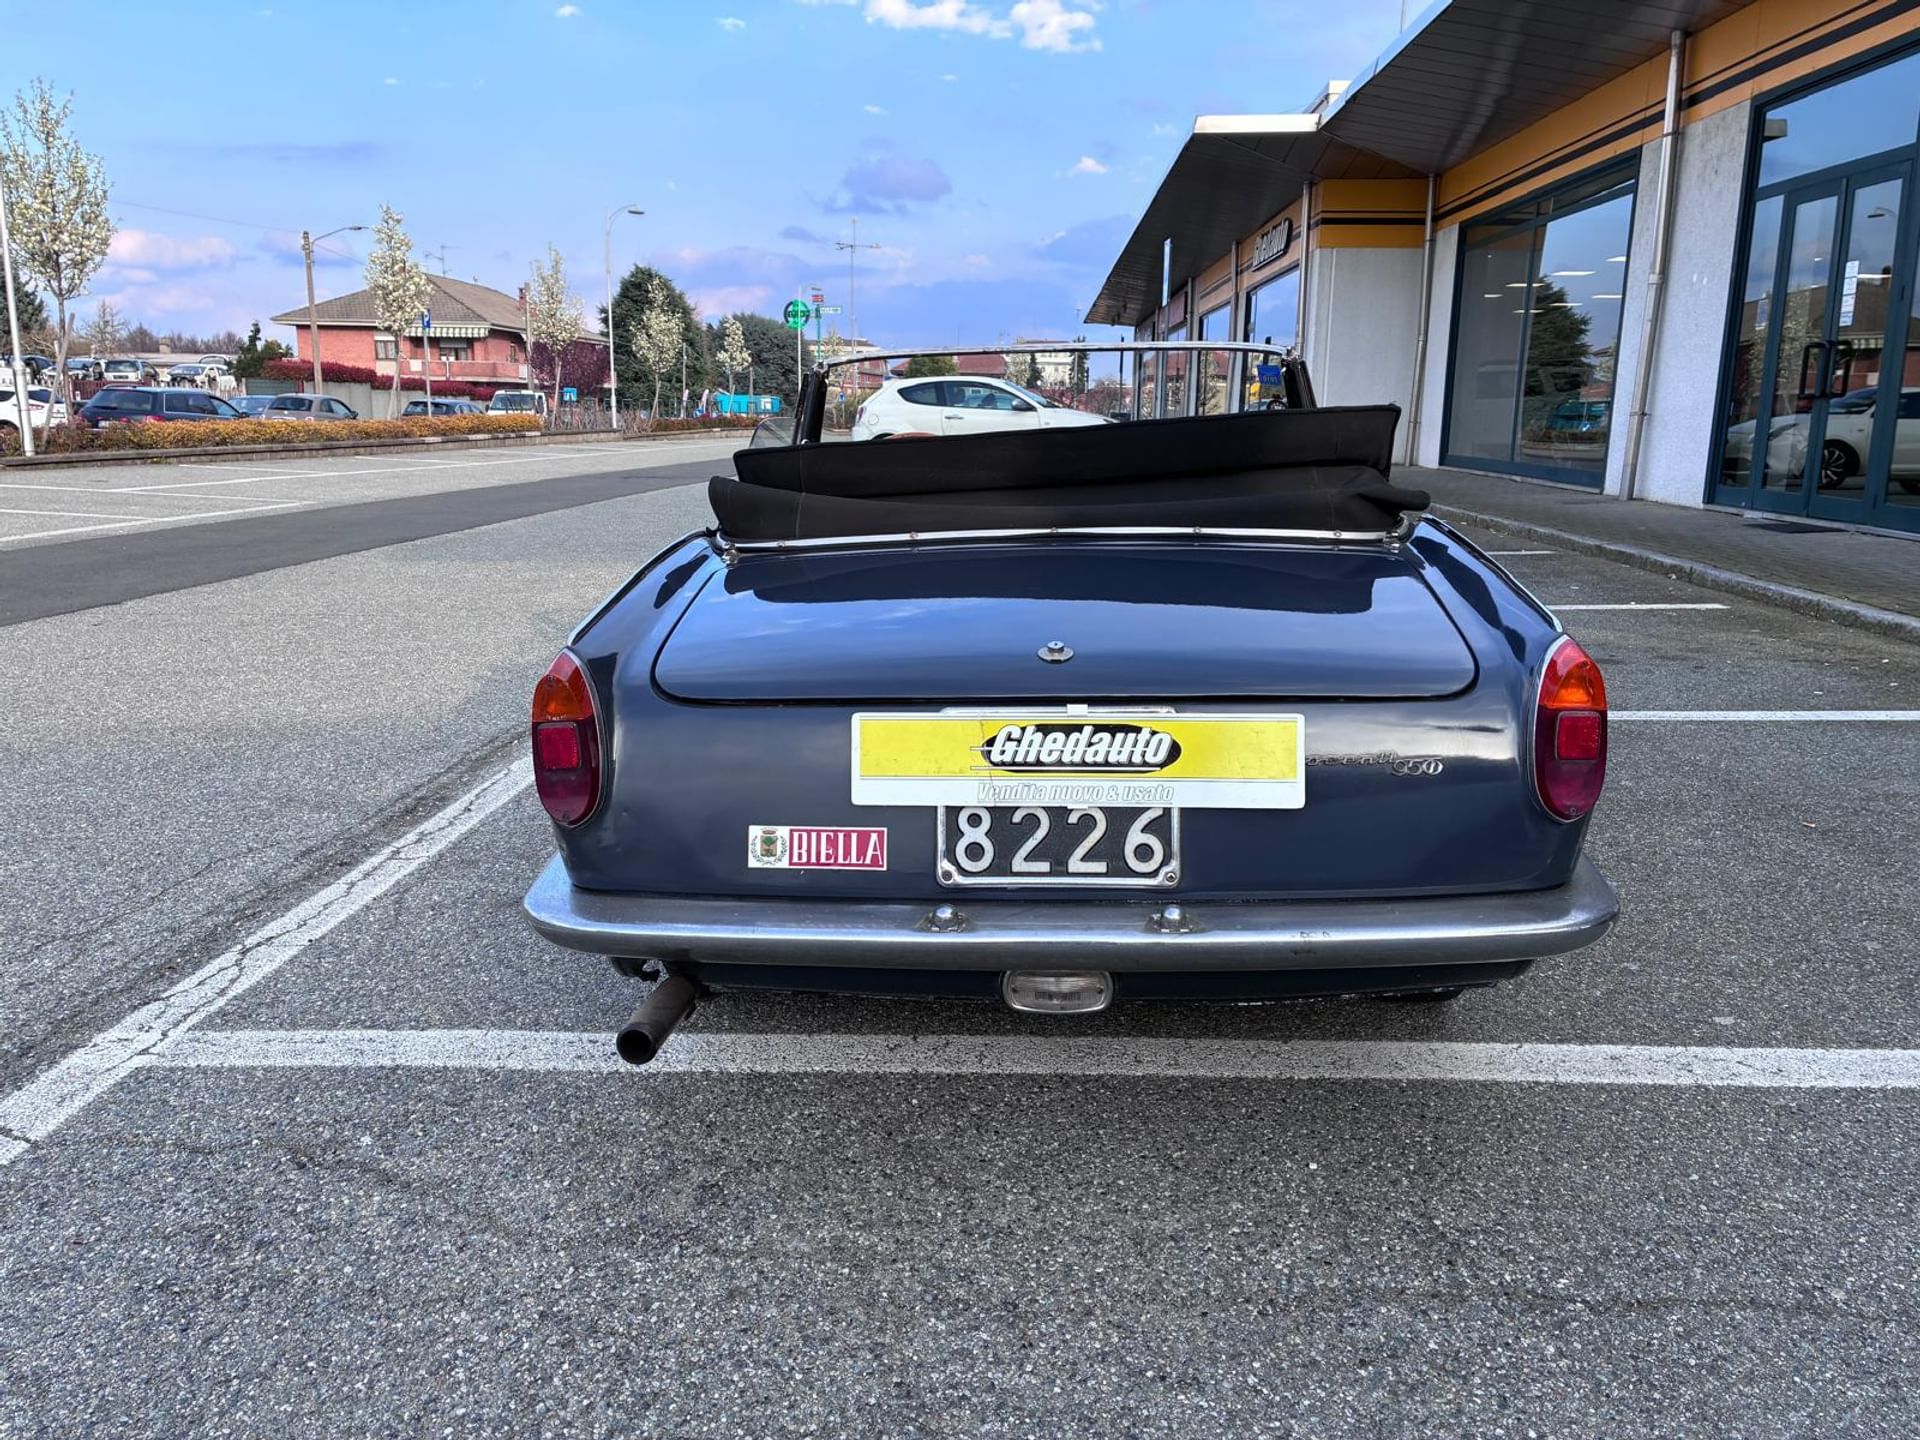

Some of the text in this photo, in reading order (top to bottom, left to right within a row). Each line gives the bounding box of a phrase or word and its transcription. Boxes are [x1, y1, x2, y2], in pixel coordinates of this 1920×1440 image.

[990, 724, 1173, 765] Ghedauto
[1391, 758, 1444, 776] 950
[977, 782, 1174, 801] Vendita nuovo & usato
[791, 830, 883, 865] BIELLA
[955, 806, 1164, 874] 8226
